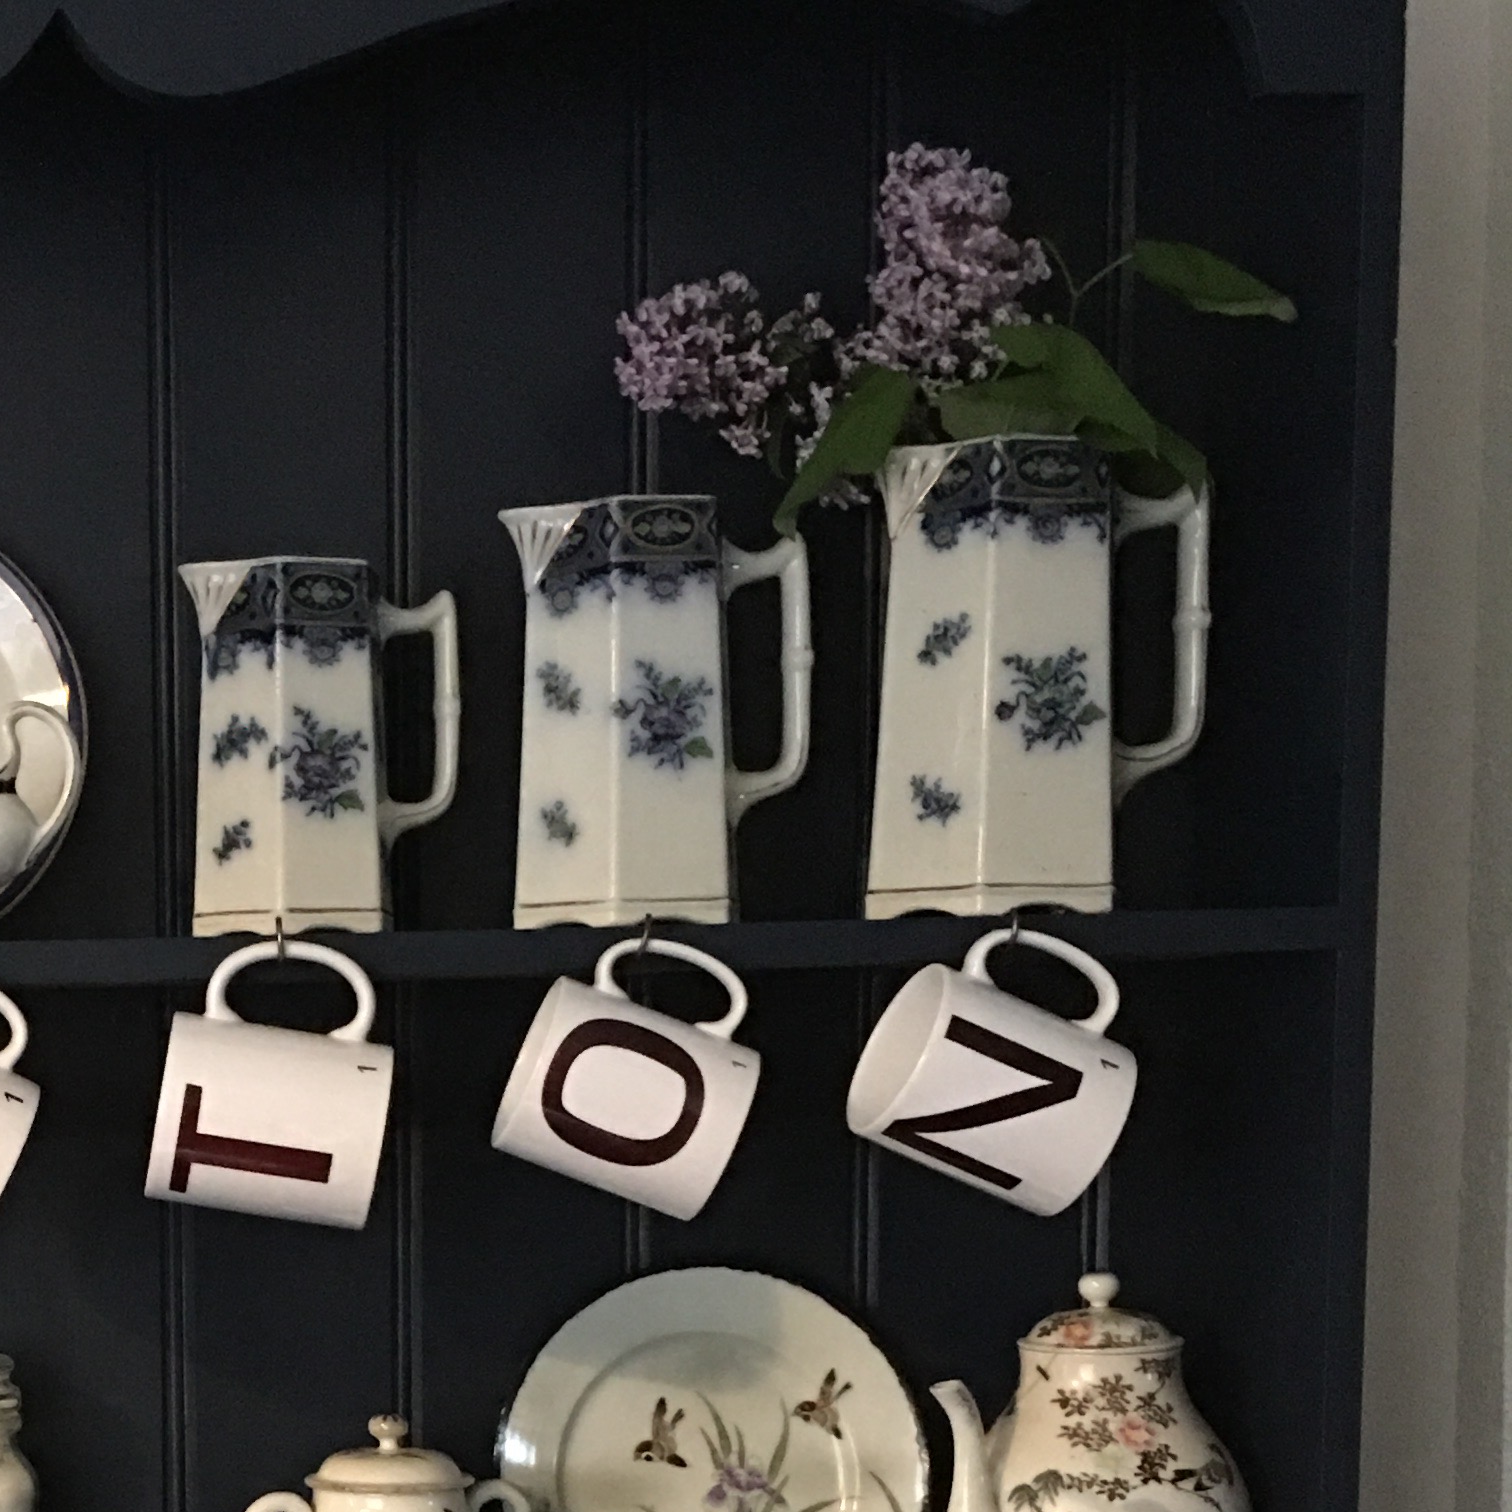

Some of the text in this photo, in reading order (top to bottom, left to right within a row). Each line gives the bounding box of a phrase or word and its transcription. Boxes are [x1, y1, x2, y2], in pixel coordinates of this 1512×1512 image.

[356, 1063, 377, 1074] 1
[732, 1059, 748, 1070] 1
[1100, 1058, 1120, 1071] 1
[4, 1090, 25, 1105] 1
[541, 1018, 705, 1167] O
[881, 1014, 1085, 1192] N
[170, 1083, 333, 1193] T
